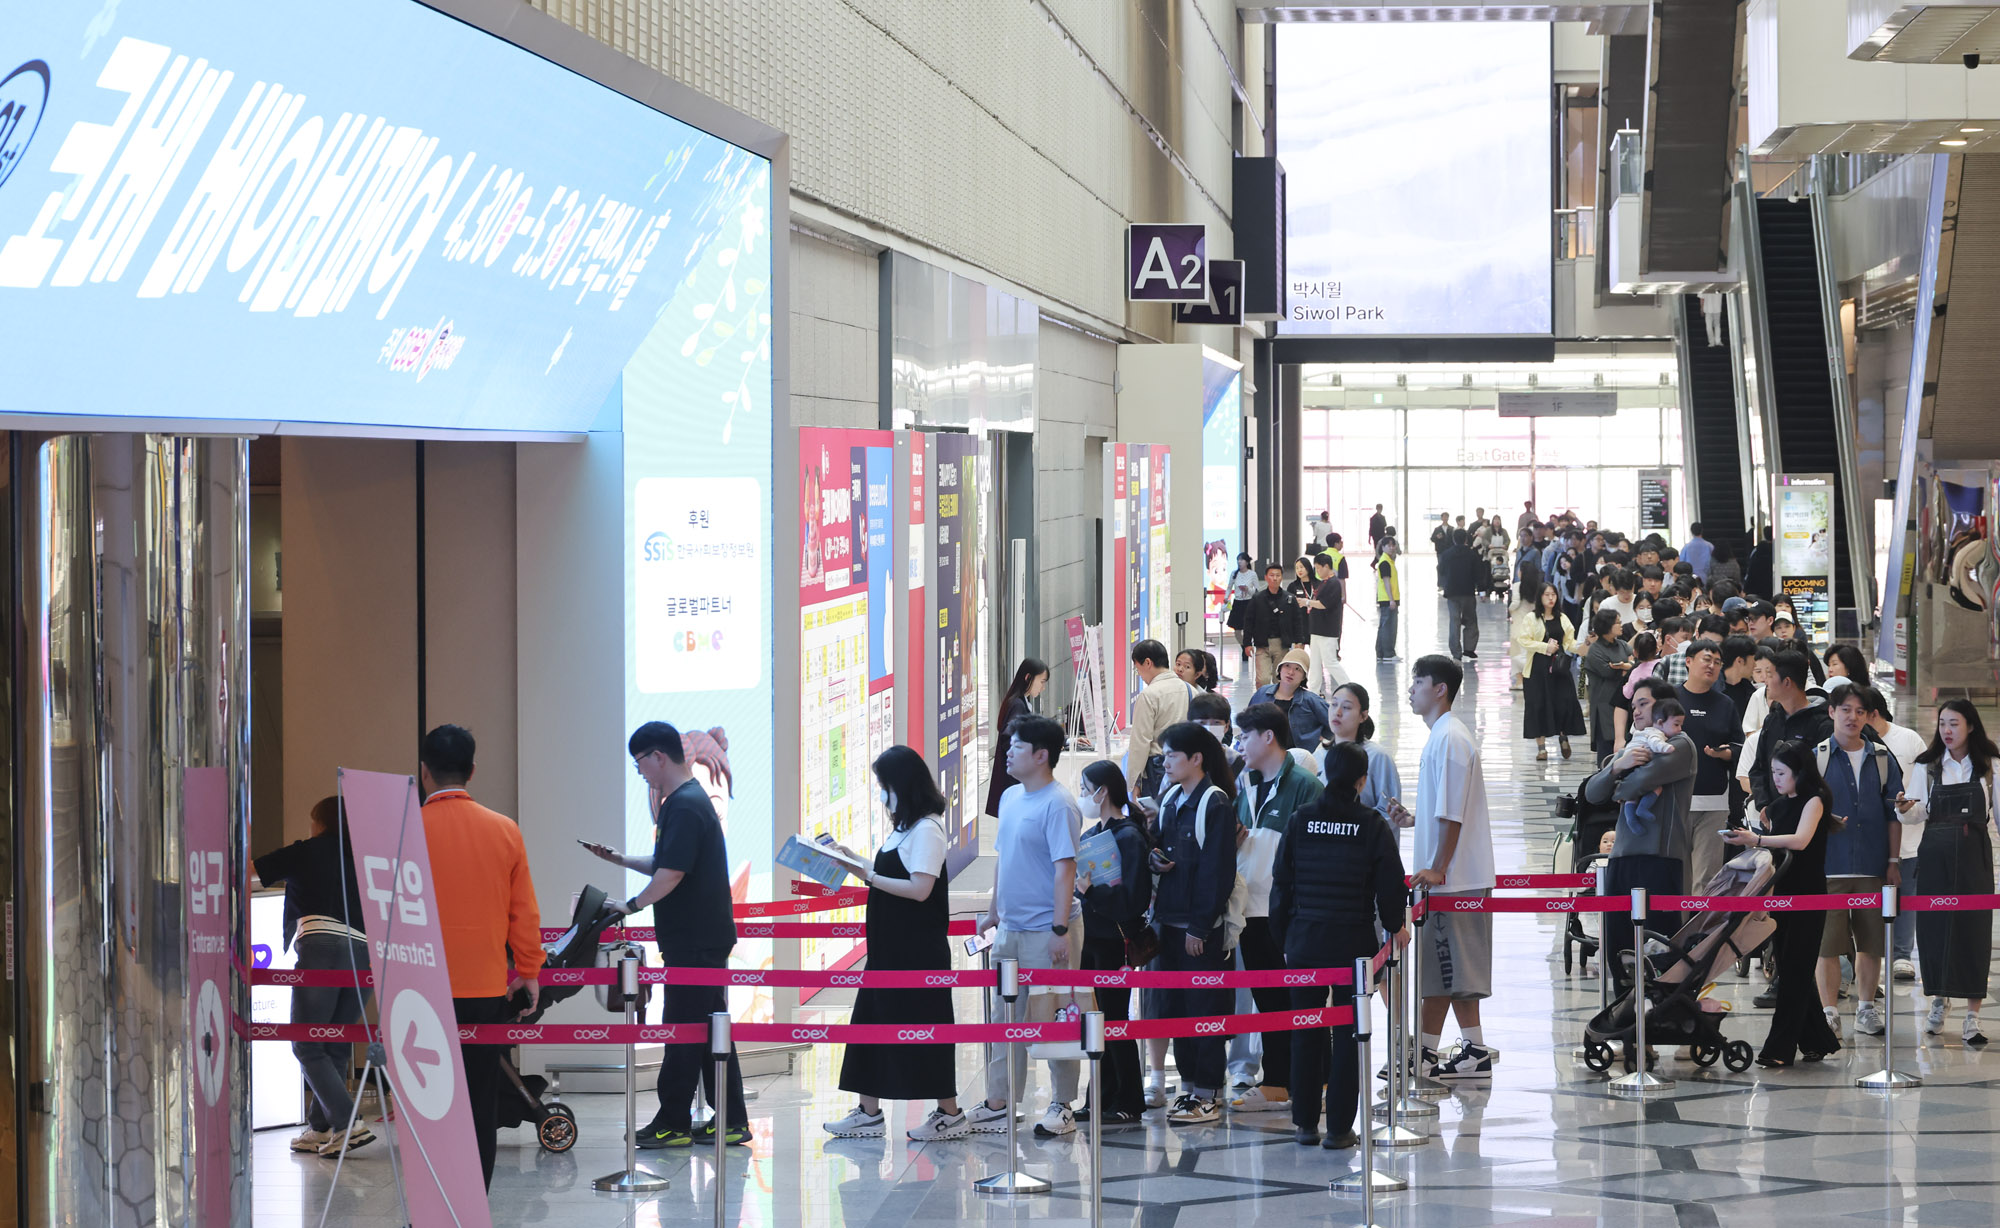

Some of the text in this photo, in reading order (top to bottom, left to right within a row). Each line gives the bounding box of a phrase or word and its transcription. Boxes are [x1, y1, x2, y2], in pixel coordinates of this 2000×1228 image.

[0, 36, 476, 320] 코베 베이비페어
[561, 199, 643, 305] 코엑스
[1134, 237, 1201, 289] A2
[1293, 282, 1342, 299] 박시월
[1293, 306, 1384, 321] Siwol Park
[1457, 448, 1525, 462] East Gate
[688, 510, 709, 529] 후원
[1783, 579, 1826, 587] UPCOMING
[1783, 587, 1814, 595] EVENTS
[667, 596, 731, 617] 글로벌파트너
[1307, 821, 1360, 836] SECURITY
[189, 851, 224, 915] 입구
[1503, 875, 1596, 887] coex co
[749, 895, 855, 915] coex coex coex
[1454, 894, 1876, 911] coex coex coex coex coex
[744, 924, 775, 936] coex
[832, 924, 861, 936] coex
[272, 972, 305, 983] coex
[552, 971, 585, 983] coex
[731, 971, 765, 984] coex
[830, 972, 864, 985] coex
[925, 972, 959, 985] coex
[1094, 972, 1127, 985] coex
[1192, 972, 1225, 985] coex
[1284, 971, 1316, 984] coex
[252, 1024, 279, 1037] oex
[309, 1025, 345, 1038] coex
[507, 1026, 543, 1039] coex
[573, 1026, 610, 1039] coex
[640, 1026, 676, 1039] coex
[791, 1026, 829, 1040] coex
[897, 1026, 935, 1040] coex
[1005, 1025, 1042, 1039] coex
[1104, 1023, 1128, 1037] oex
[1195, 1018, 1226, 1033] coex
[1292, 1011, 1323, 1026] coex
